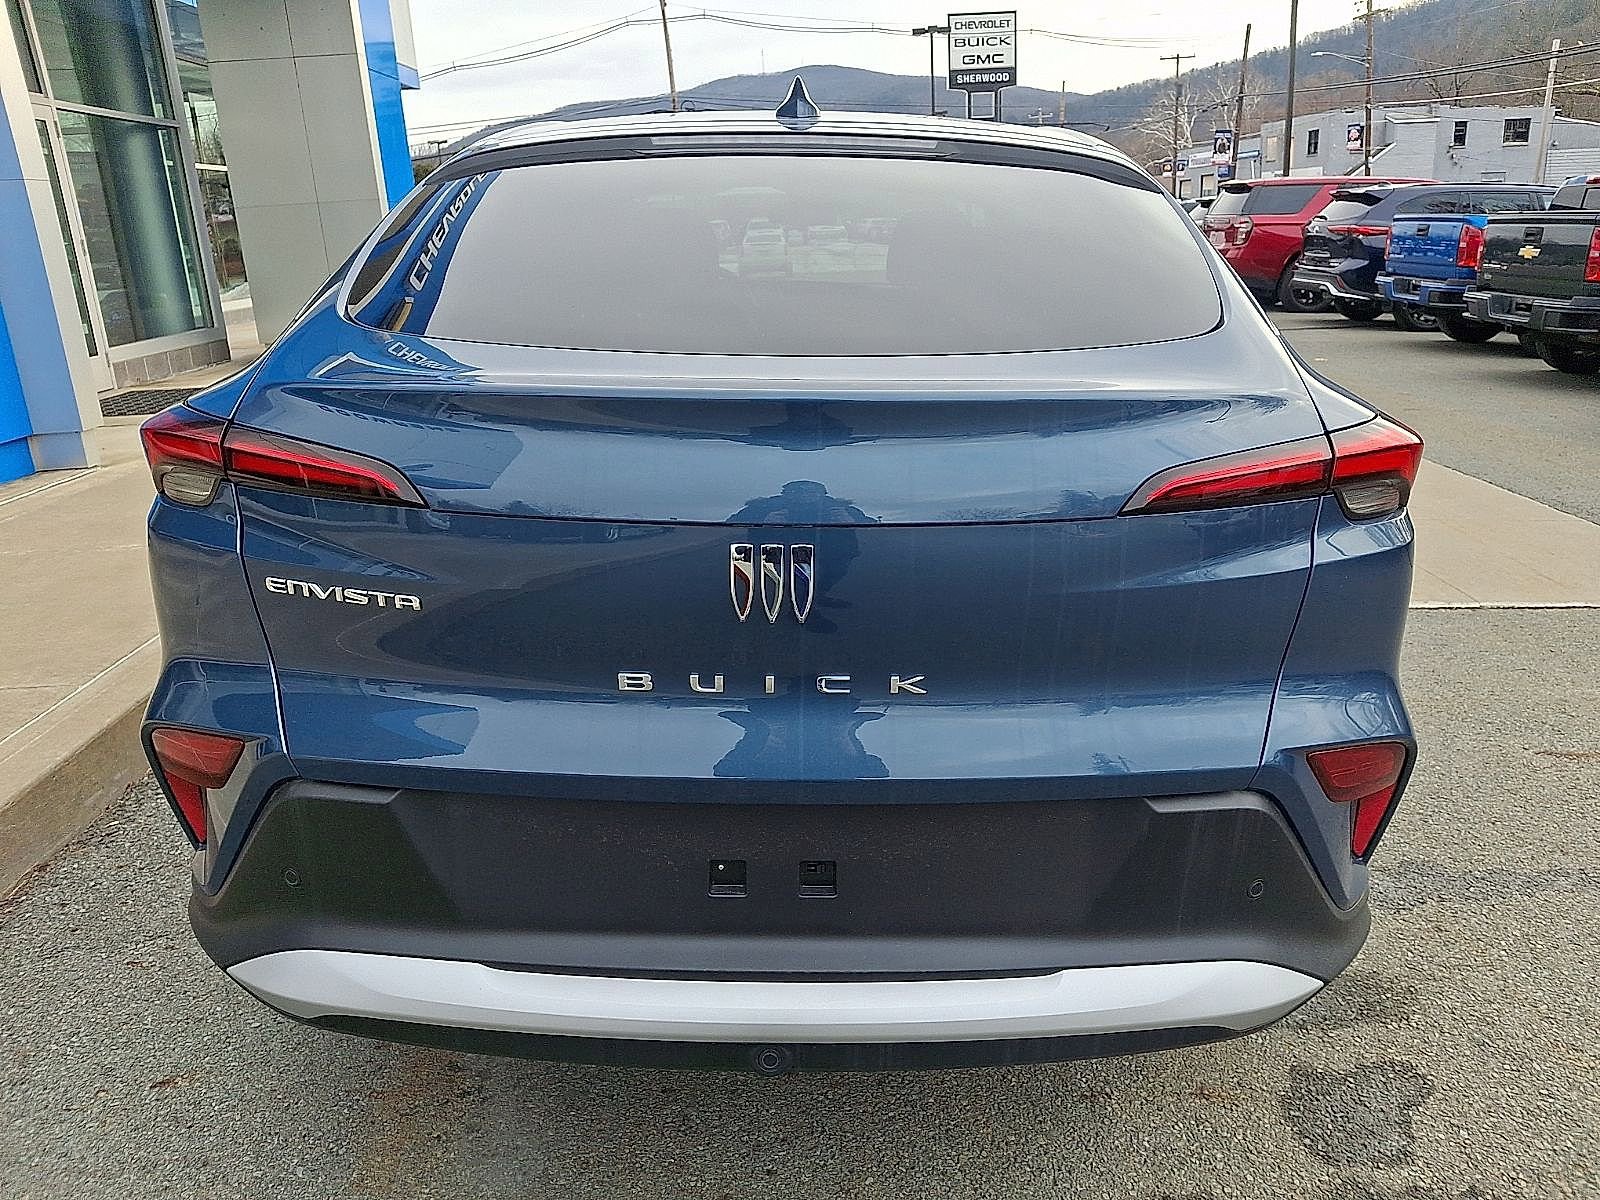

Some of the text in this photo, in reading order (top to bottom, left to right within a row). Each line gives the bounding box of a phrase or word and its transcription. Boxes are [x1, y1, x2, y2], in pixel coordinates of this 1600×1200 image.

[954, 19, 1011, 30] CHEVROLET
[954, 36, 1011, 47] BUICK
[962, 54, 1004, 64] GMC
[956, 73, 1009, 83] SHERWOOD
[265, 575, 422, 611] ENVISTA
[618, 672, 928, 694] BUICK
